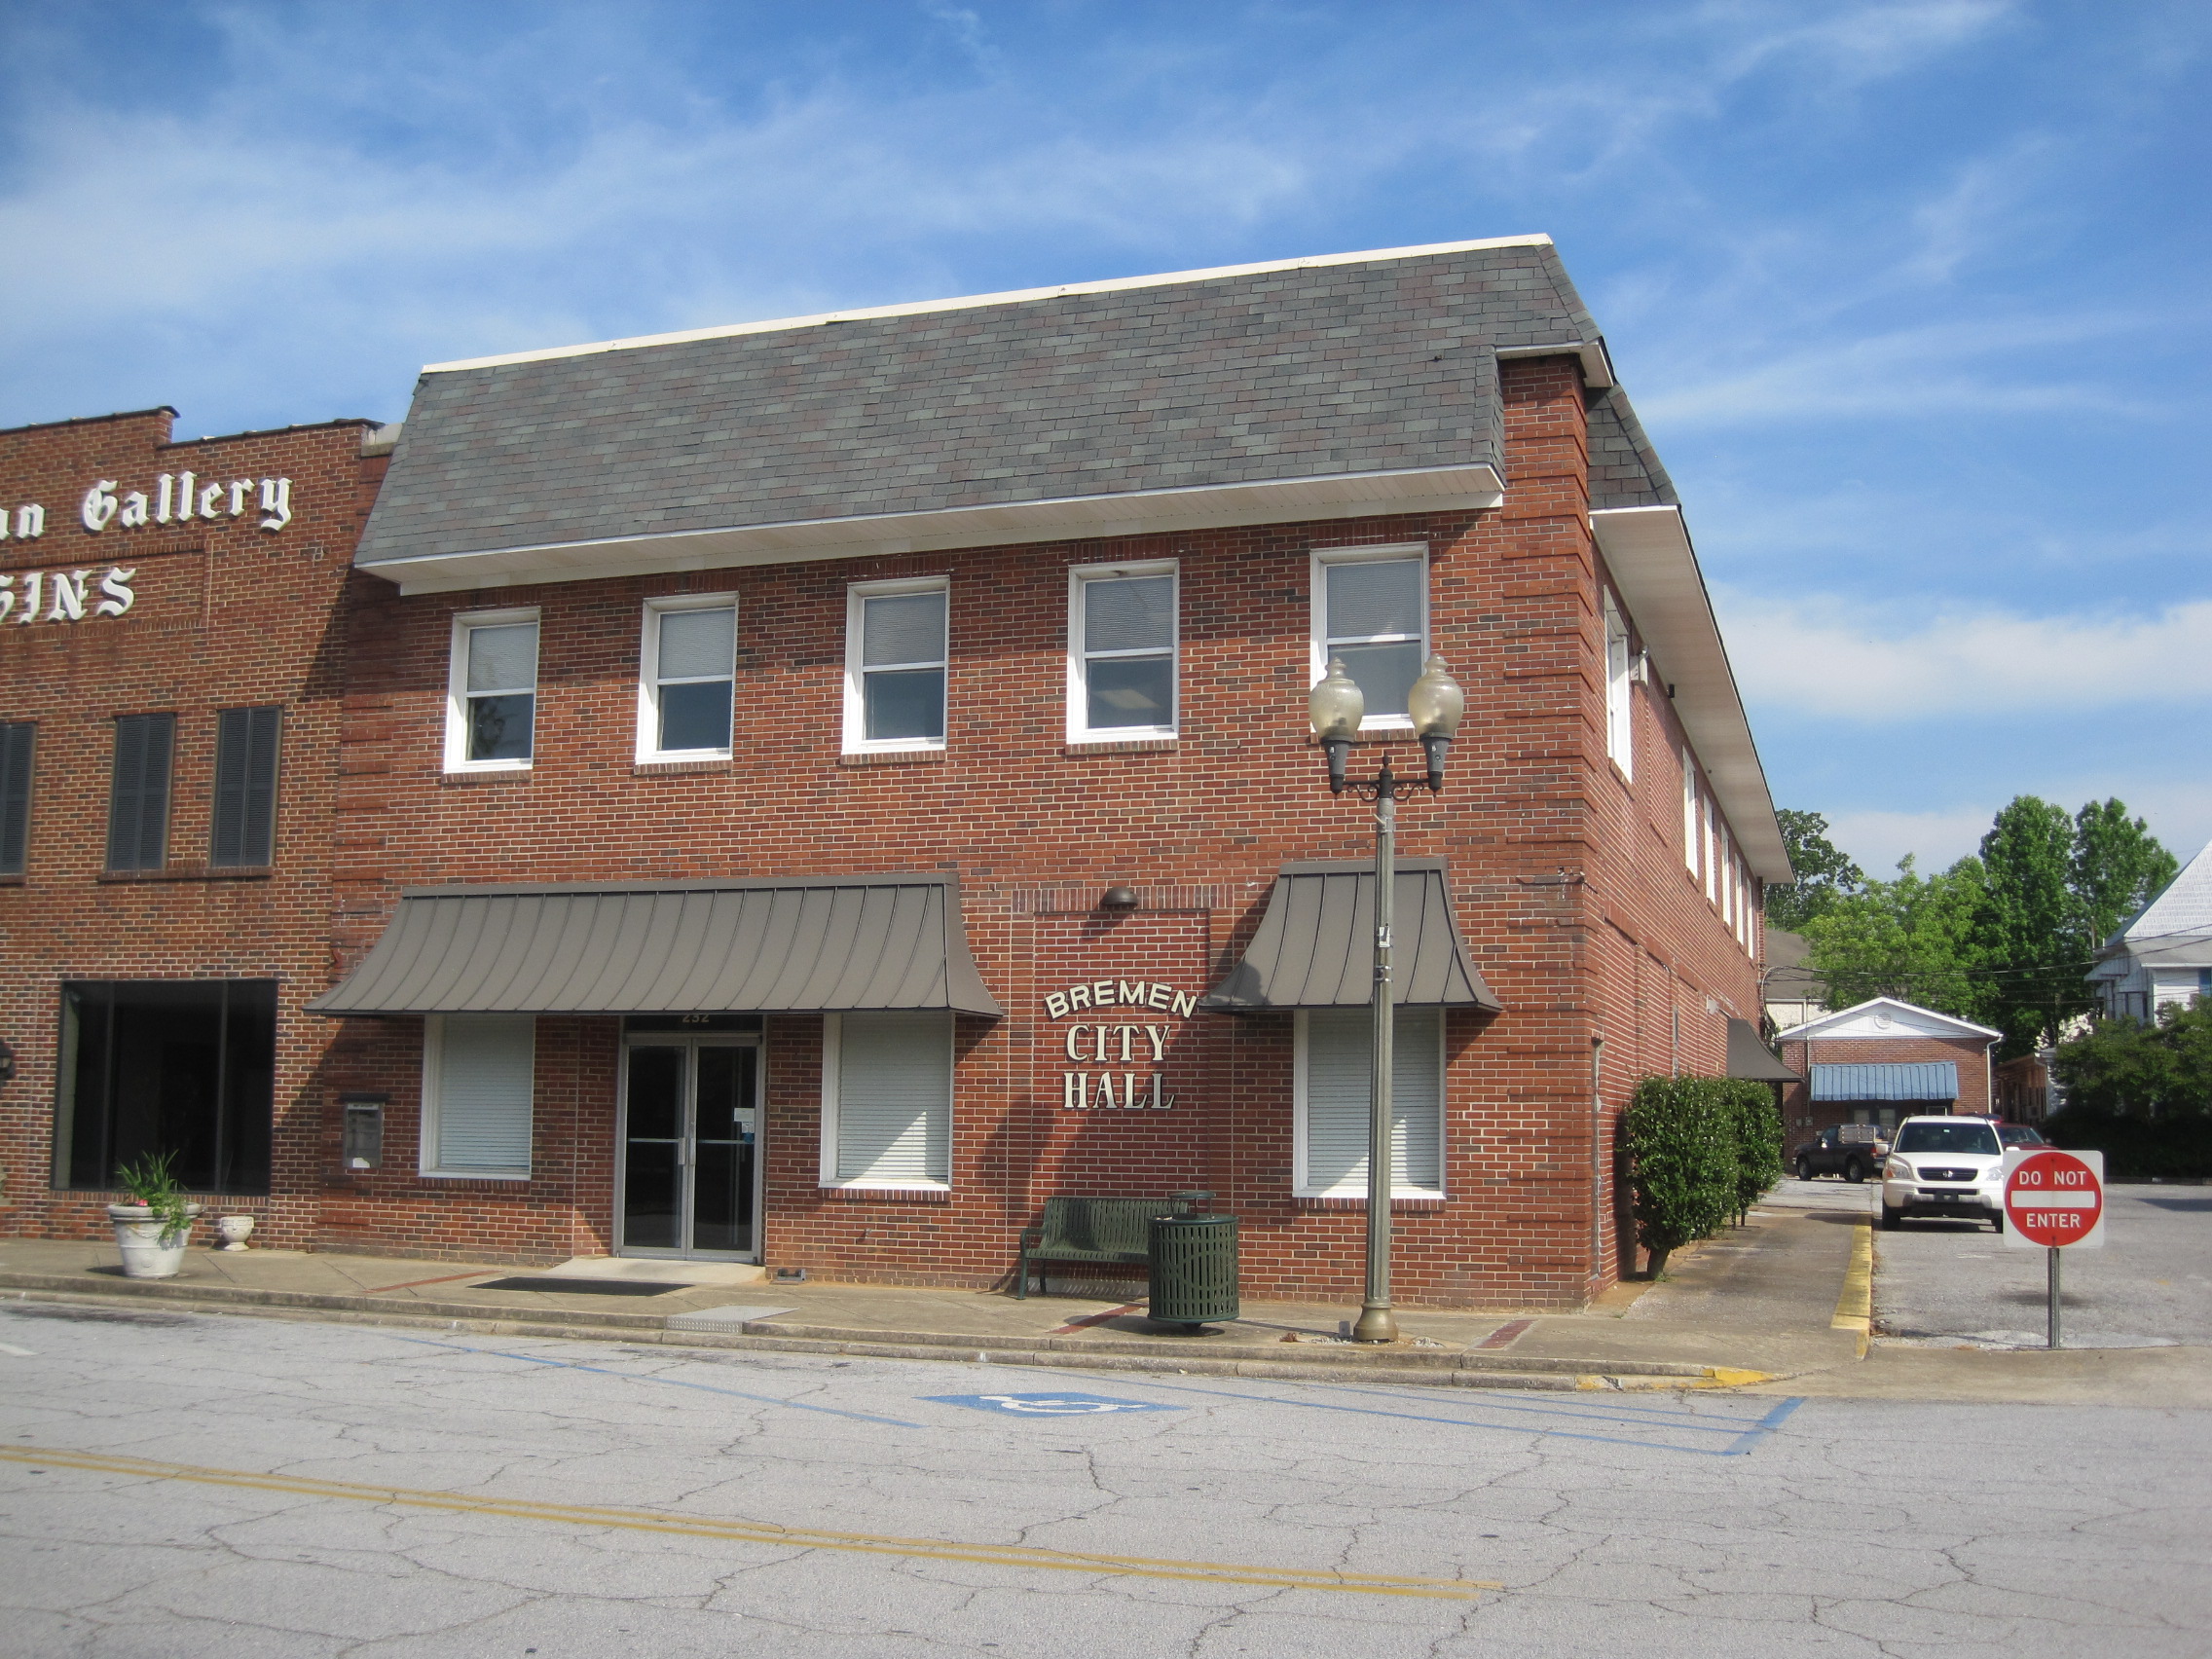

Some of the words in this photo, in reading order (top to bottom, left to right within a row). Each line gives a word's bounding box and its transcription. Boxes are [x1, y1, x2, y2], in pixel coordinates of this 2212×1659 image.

[82, 471, 294, 533] Gallery
[1045, 979, 1198, 1019] BREMEN
[1066, 1024, 1170, 1061] CITY
[1063, 1071, 1175, 1109] HALL
[2018, 1170, 2042, 1186] DO
[2053, 1170, 2086, 1186] NOT
[2026, 1213, 2081, 1228] ENTER
